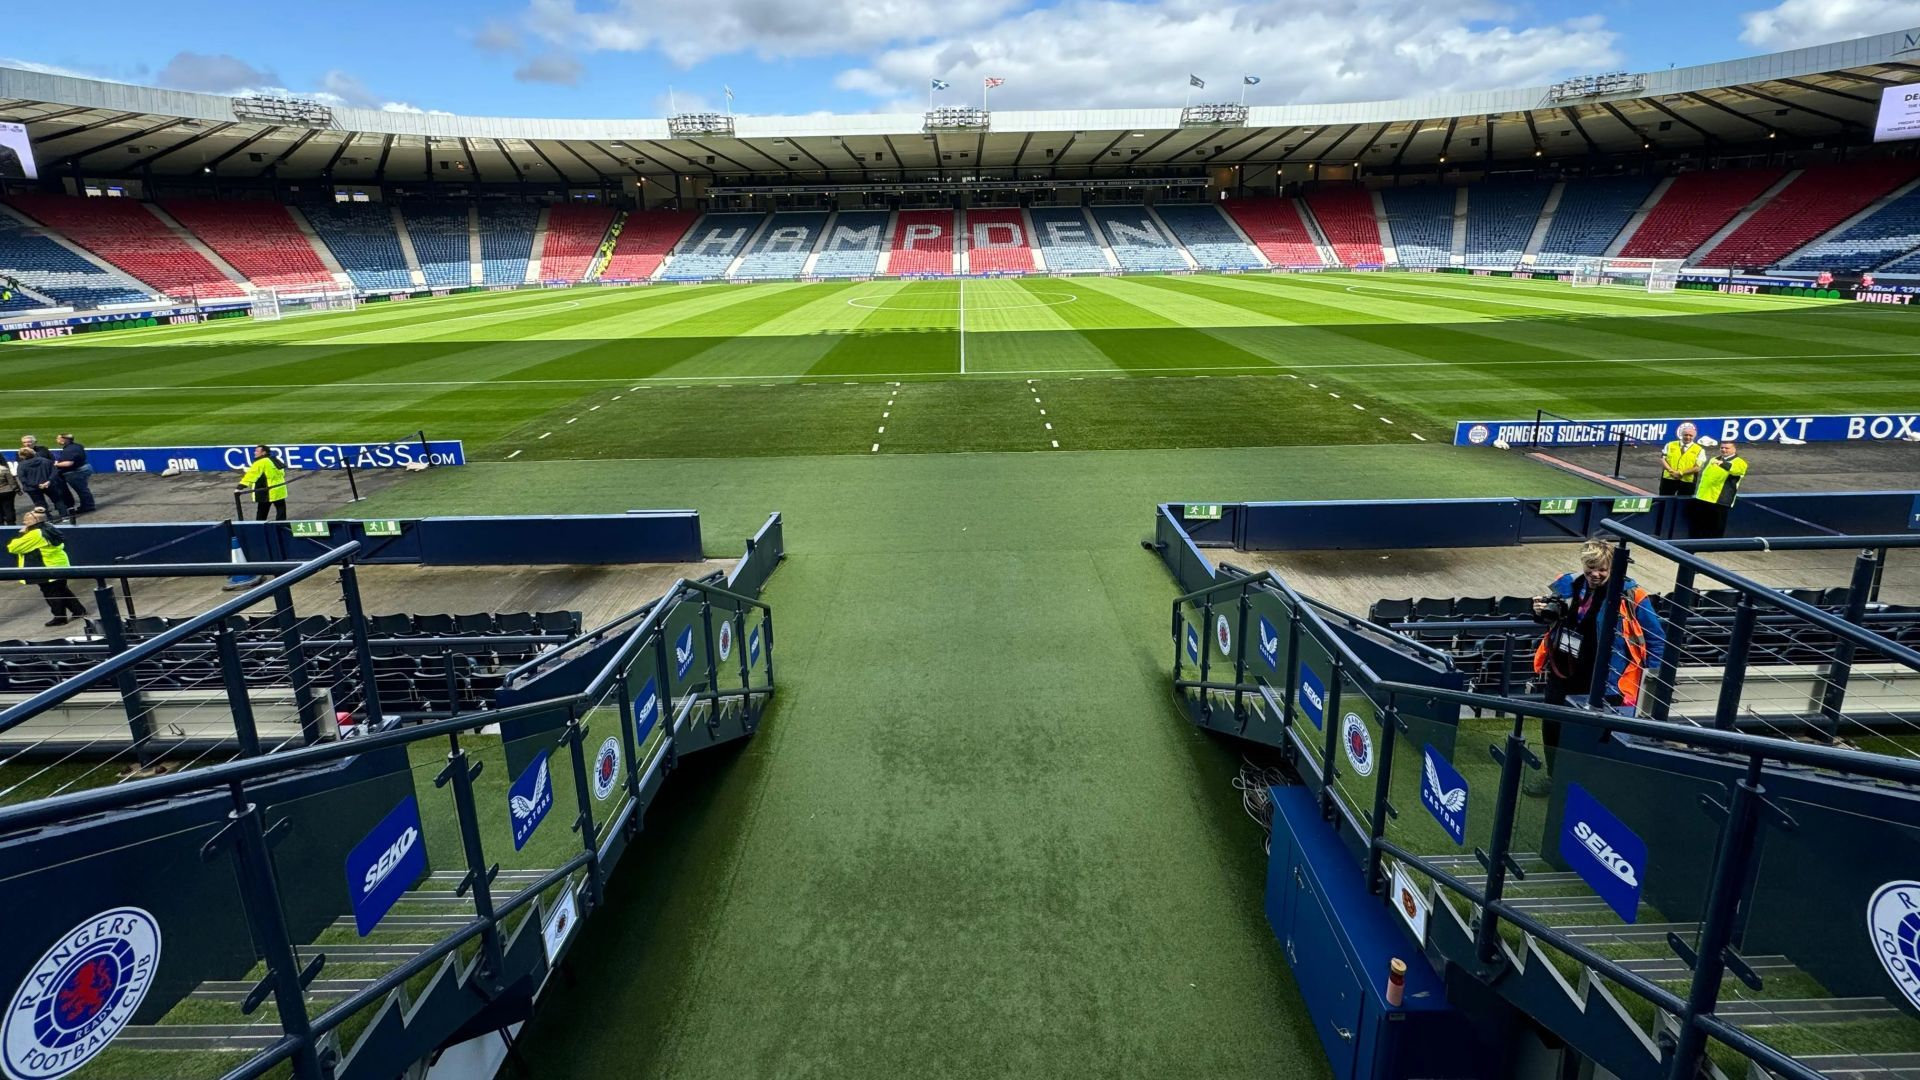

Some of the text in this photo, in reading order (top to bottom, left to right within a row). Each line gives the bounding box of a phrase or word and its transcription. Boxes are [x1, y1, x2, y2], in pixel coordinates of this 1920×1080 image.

[695, 219, 1168, 256] HAMPDEN
[1855, 291, 1914, 305] UNIBET
[19, 325, 75, 341] UNIBET
[1557, 424, 1606, 442] SOCCER
[1721, 418, 1813, 441] BOXT
[517, 793, 551, 841] CASTORE
[1423, 788, 1462, 836] CASTORE
[363, 826, 418, 893] SEKO
[1573, 821, 1638, 887] SEKO
[18, 917, 137, 1011] RANGERS
[122, 954, 151, 1009] CLUB
[20, 1013, 123, 1071] FOOTBALL
[74, 1003, 114, 1041] READY
